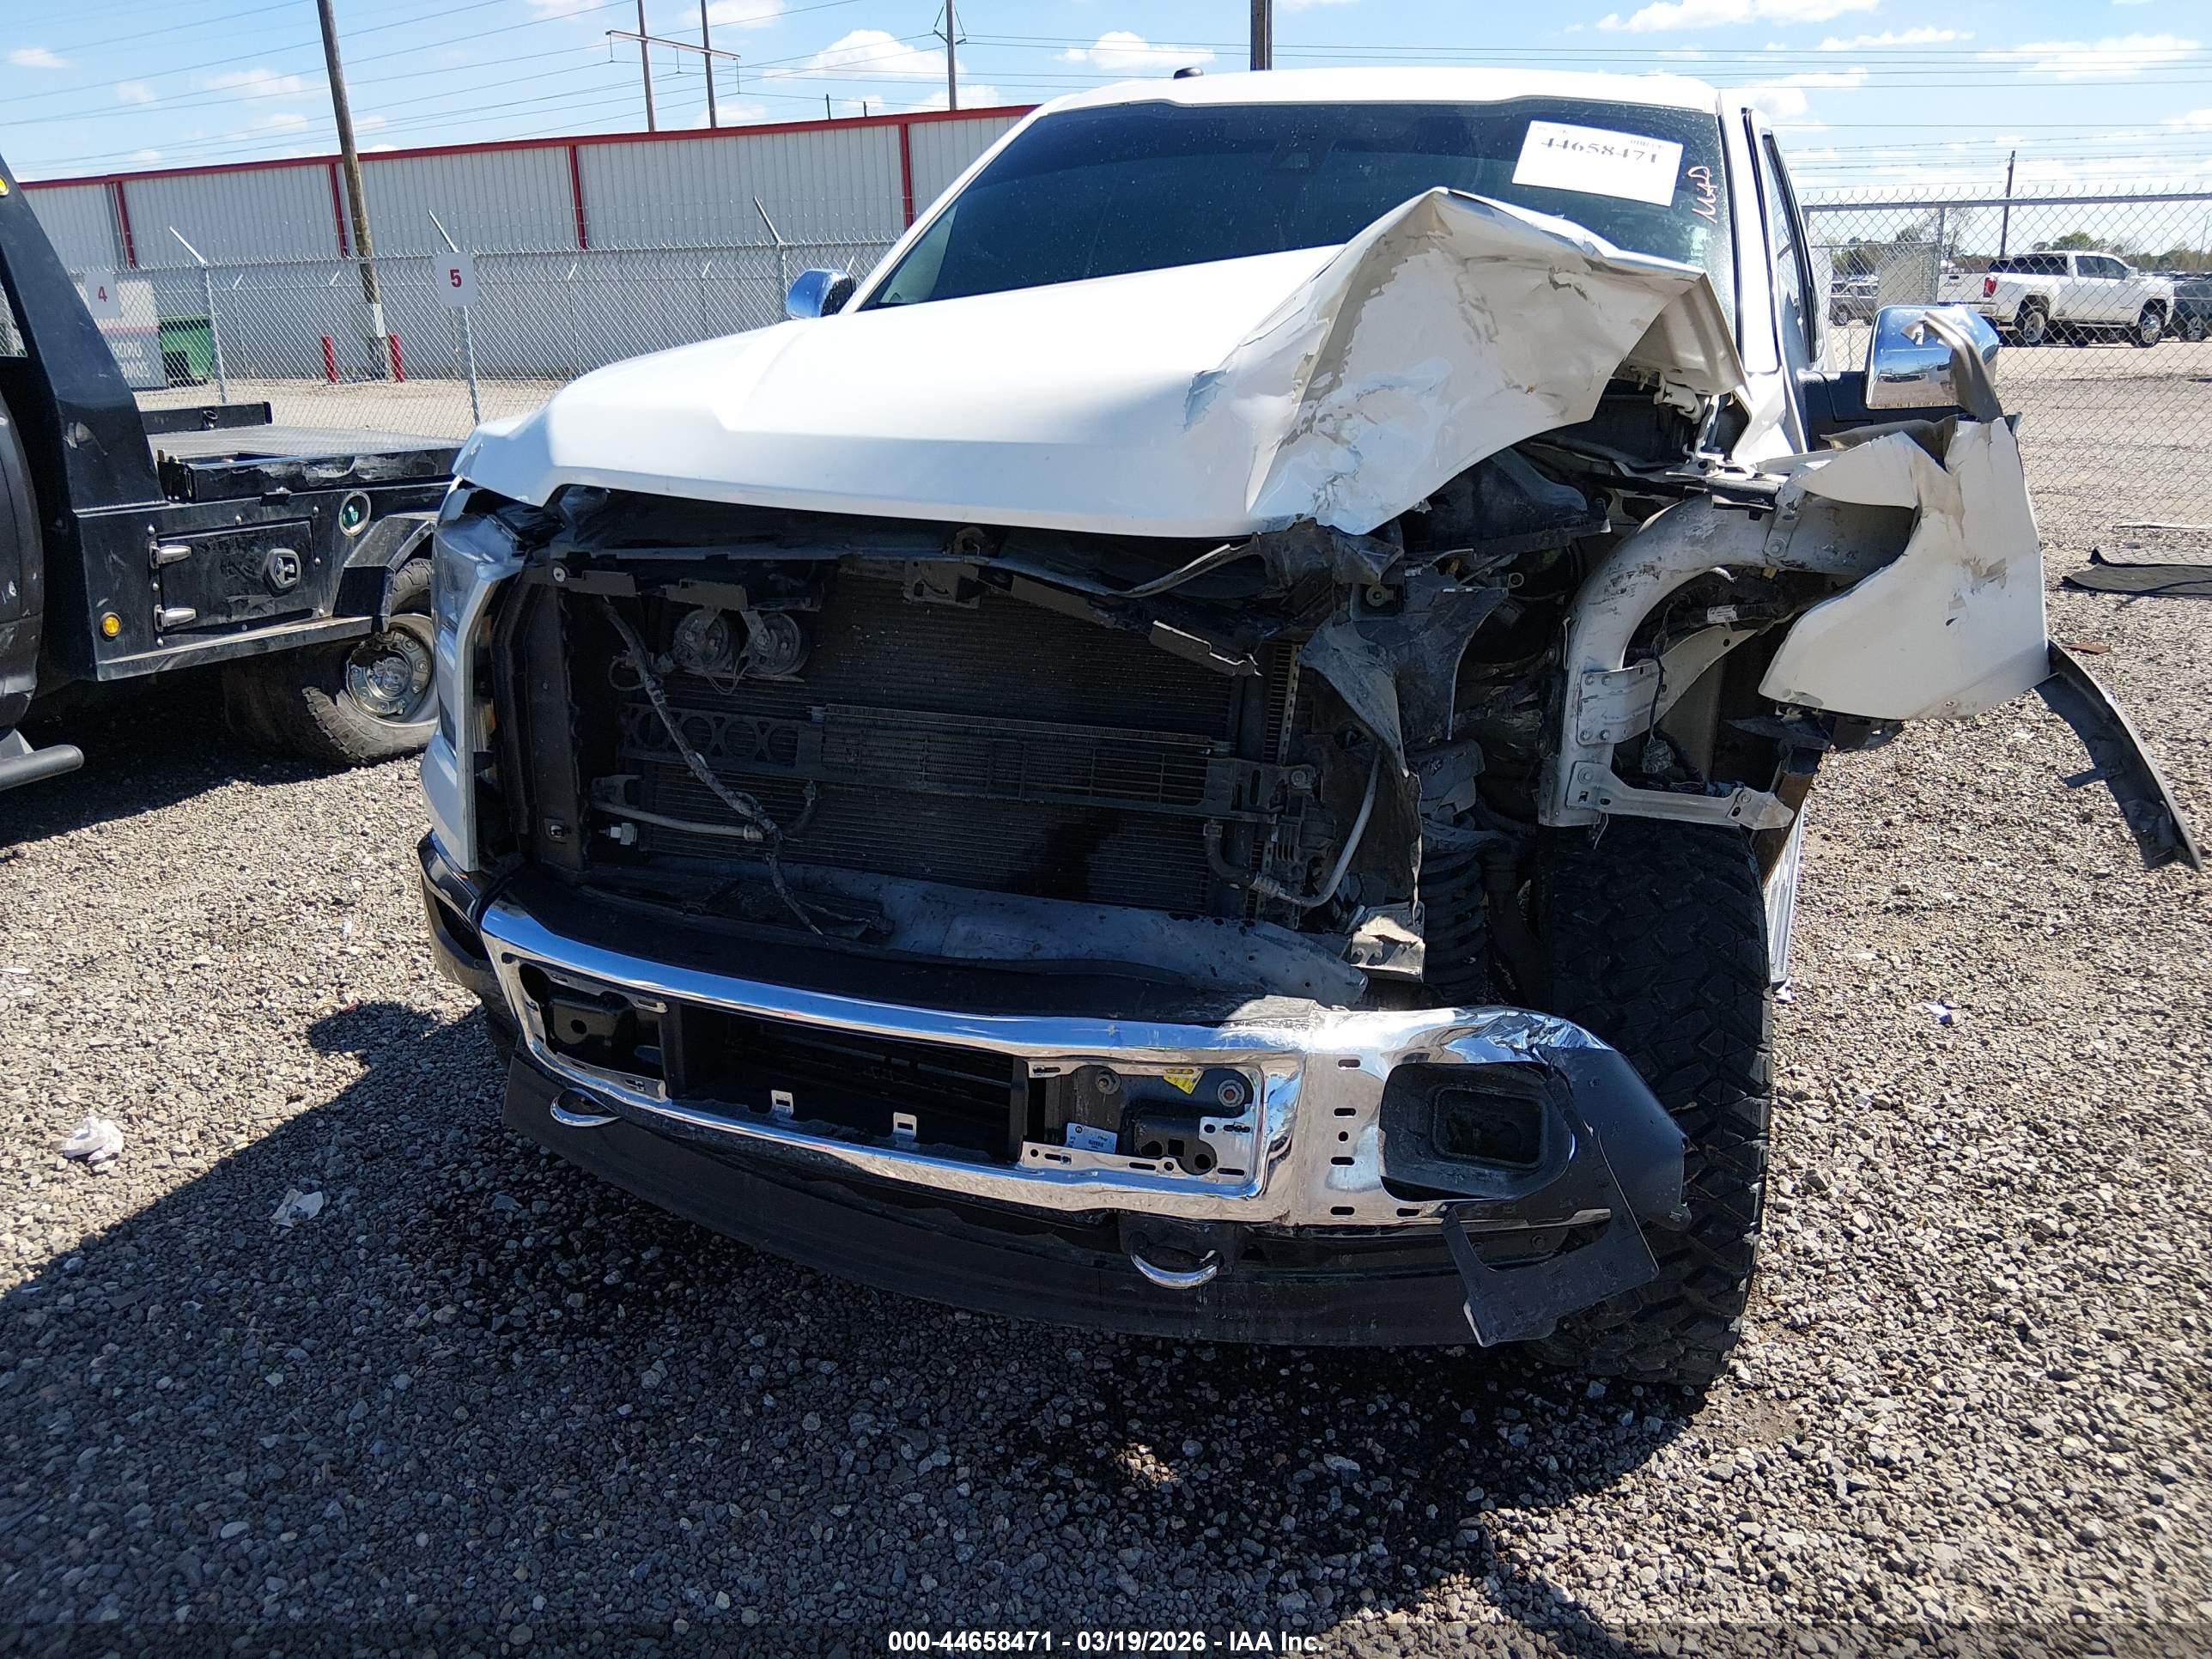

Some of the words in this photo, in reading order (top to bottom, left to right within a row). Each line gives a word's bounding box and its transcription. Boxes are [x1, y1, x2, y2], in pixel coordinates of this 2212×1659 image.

[1540, 137, 1657, 164] 44658471
[449, 269, 462, 288] 5
[98, 286, 108, 302] 4
